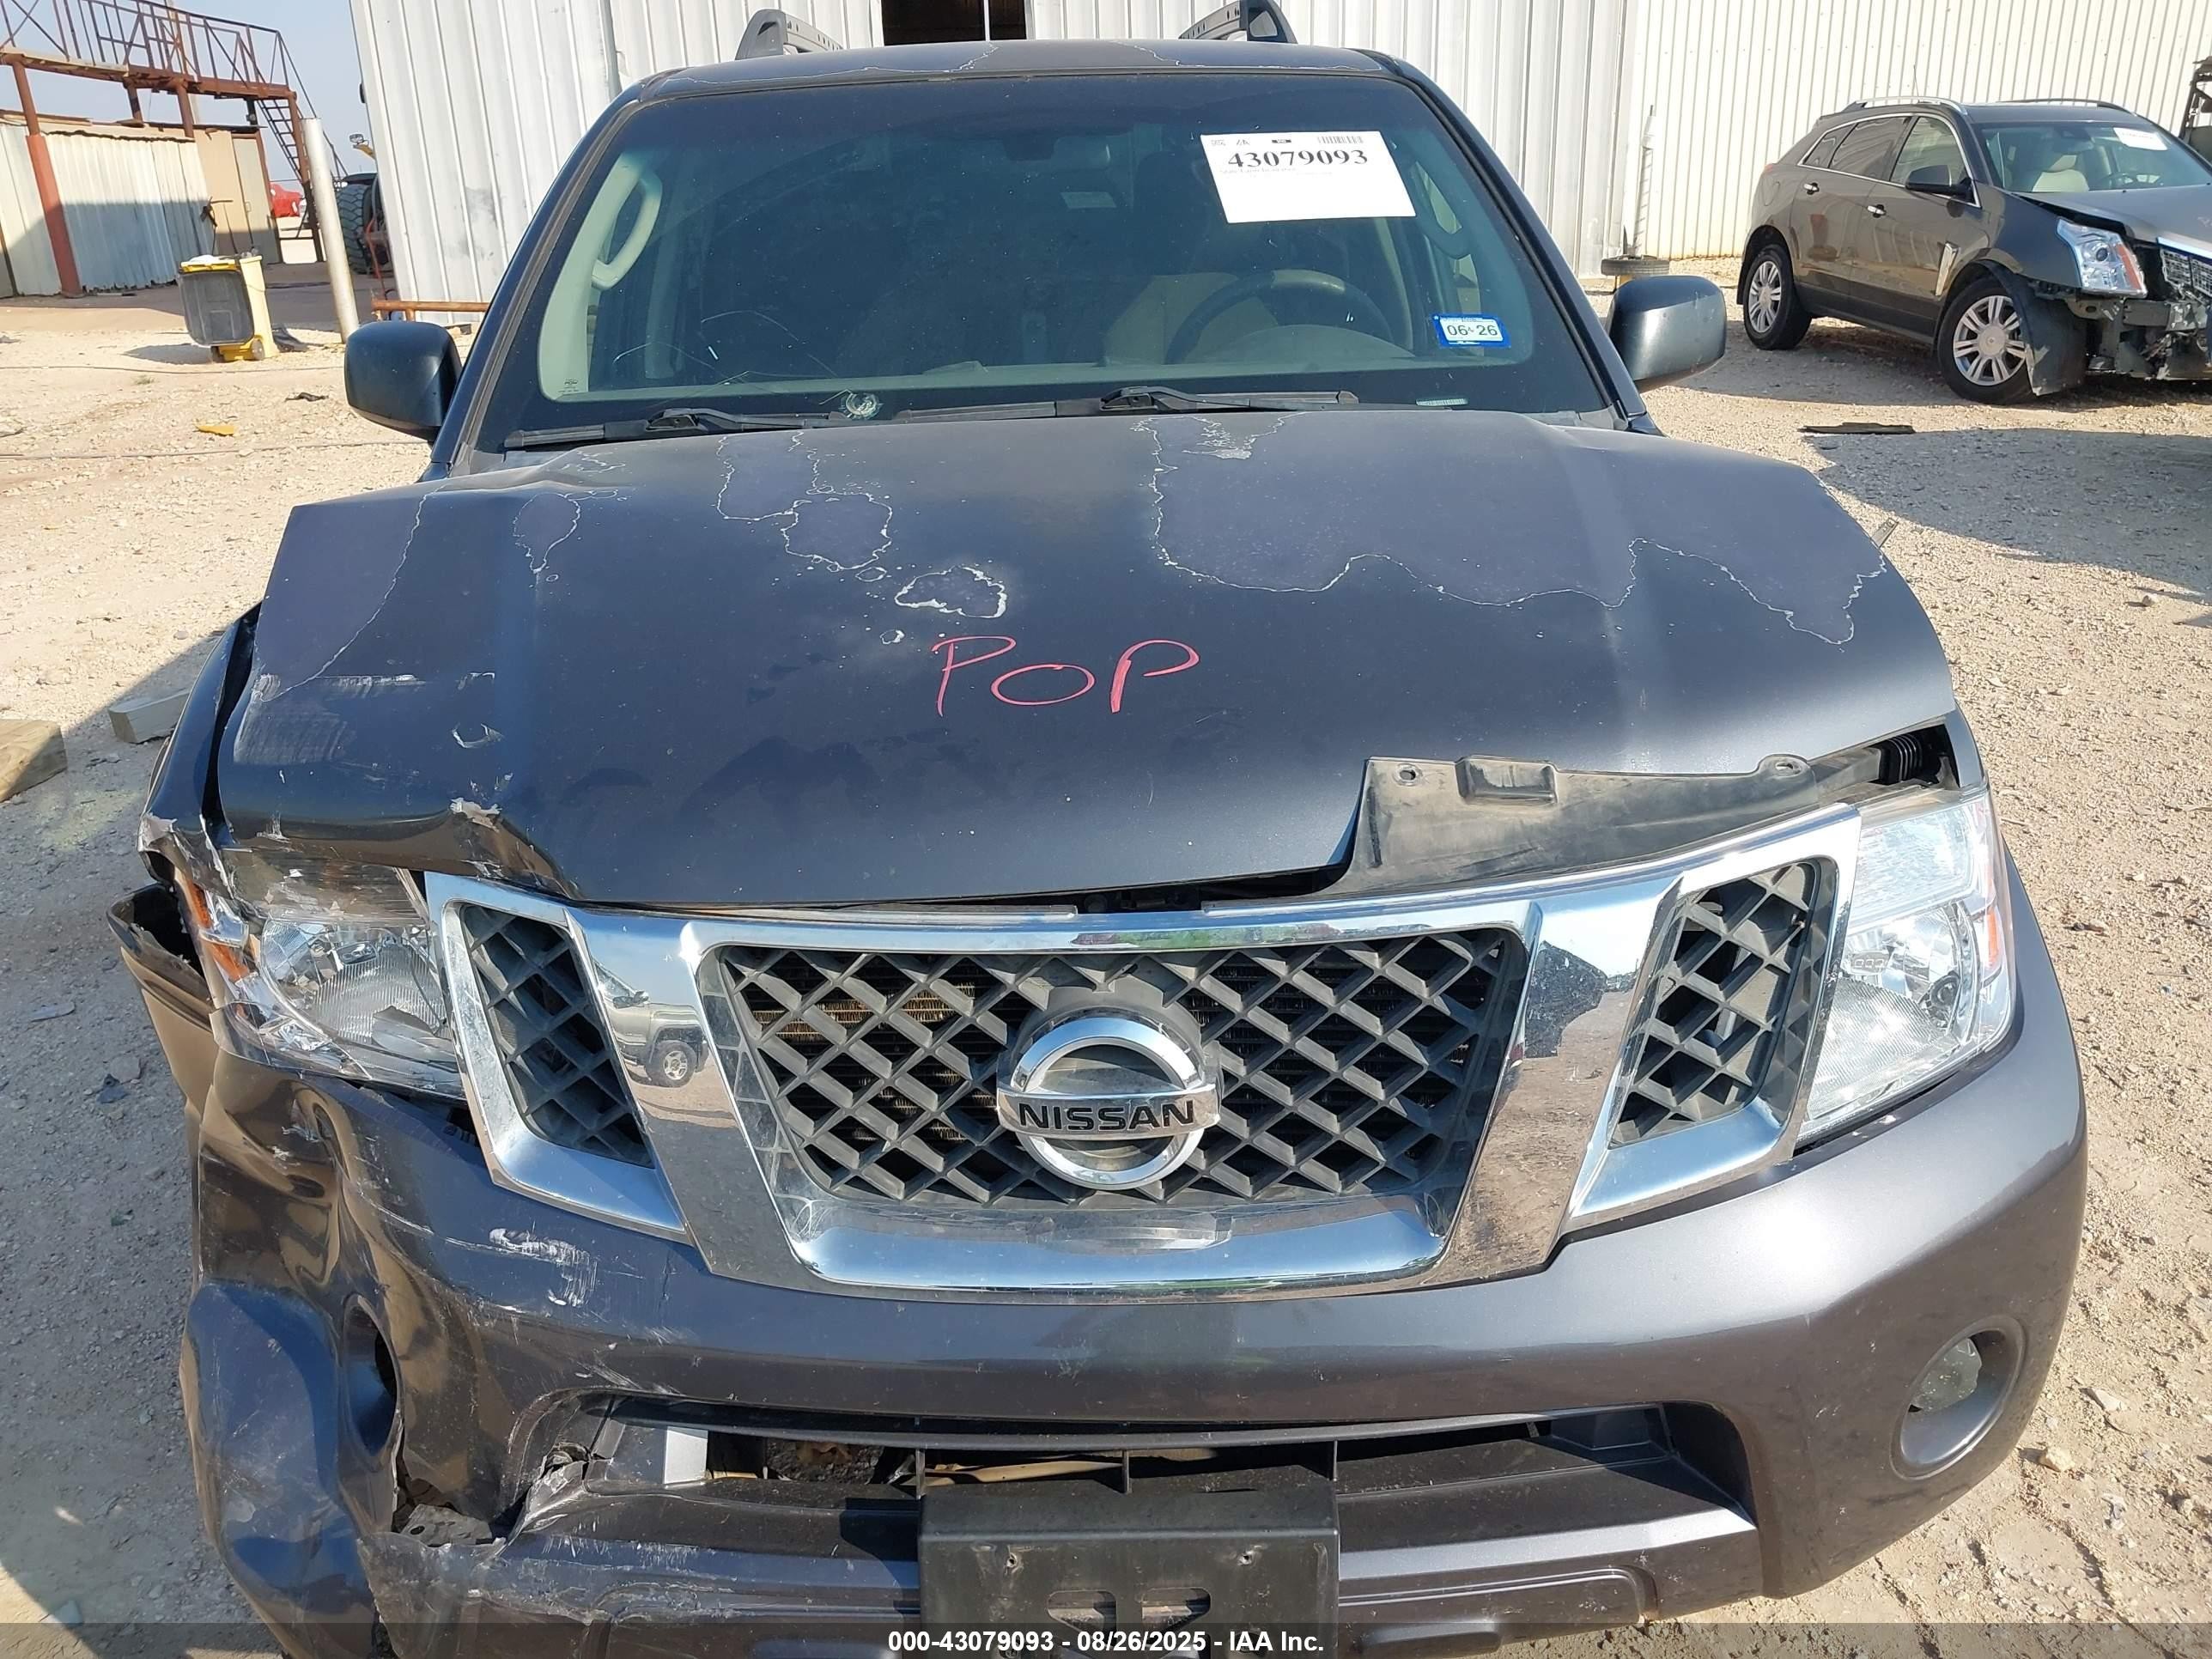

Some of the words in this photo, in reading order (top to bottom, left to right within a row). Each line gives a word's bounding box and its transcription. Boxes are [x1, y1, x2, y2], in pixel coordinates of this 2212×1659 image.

[1228, 149, 1368, 167] 43079093
[1446, 325, 1468, 336] 06
[1476, 325, 1498, 336] 26
[1018, 1100, 1194, 1131] NISSAN
